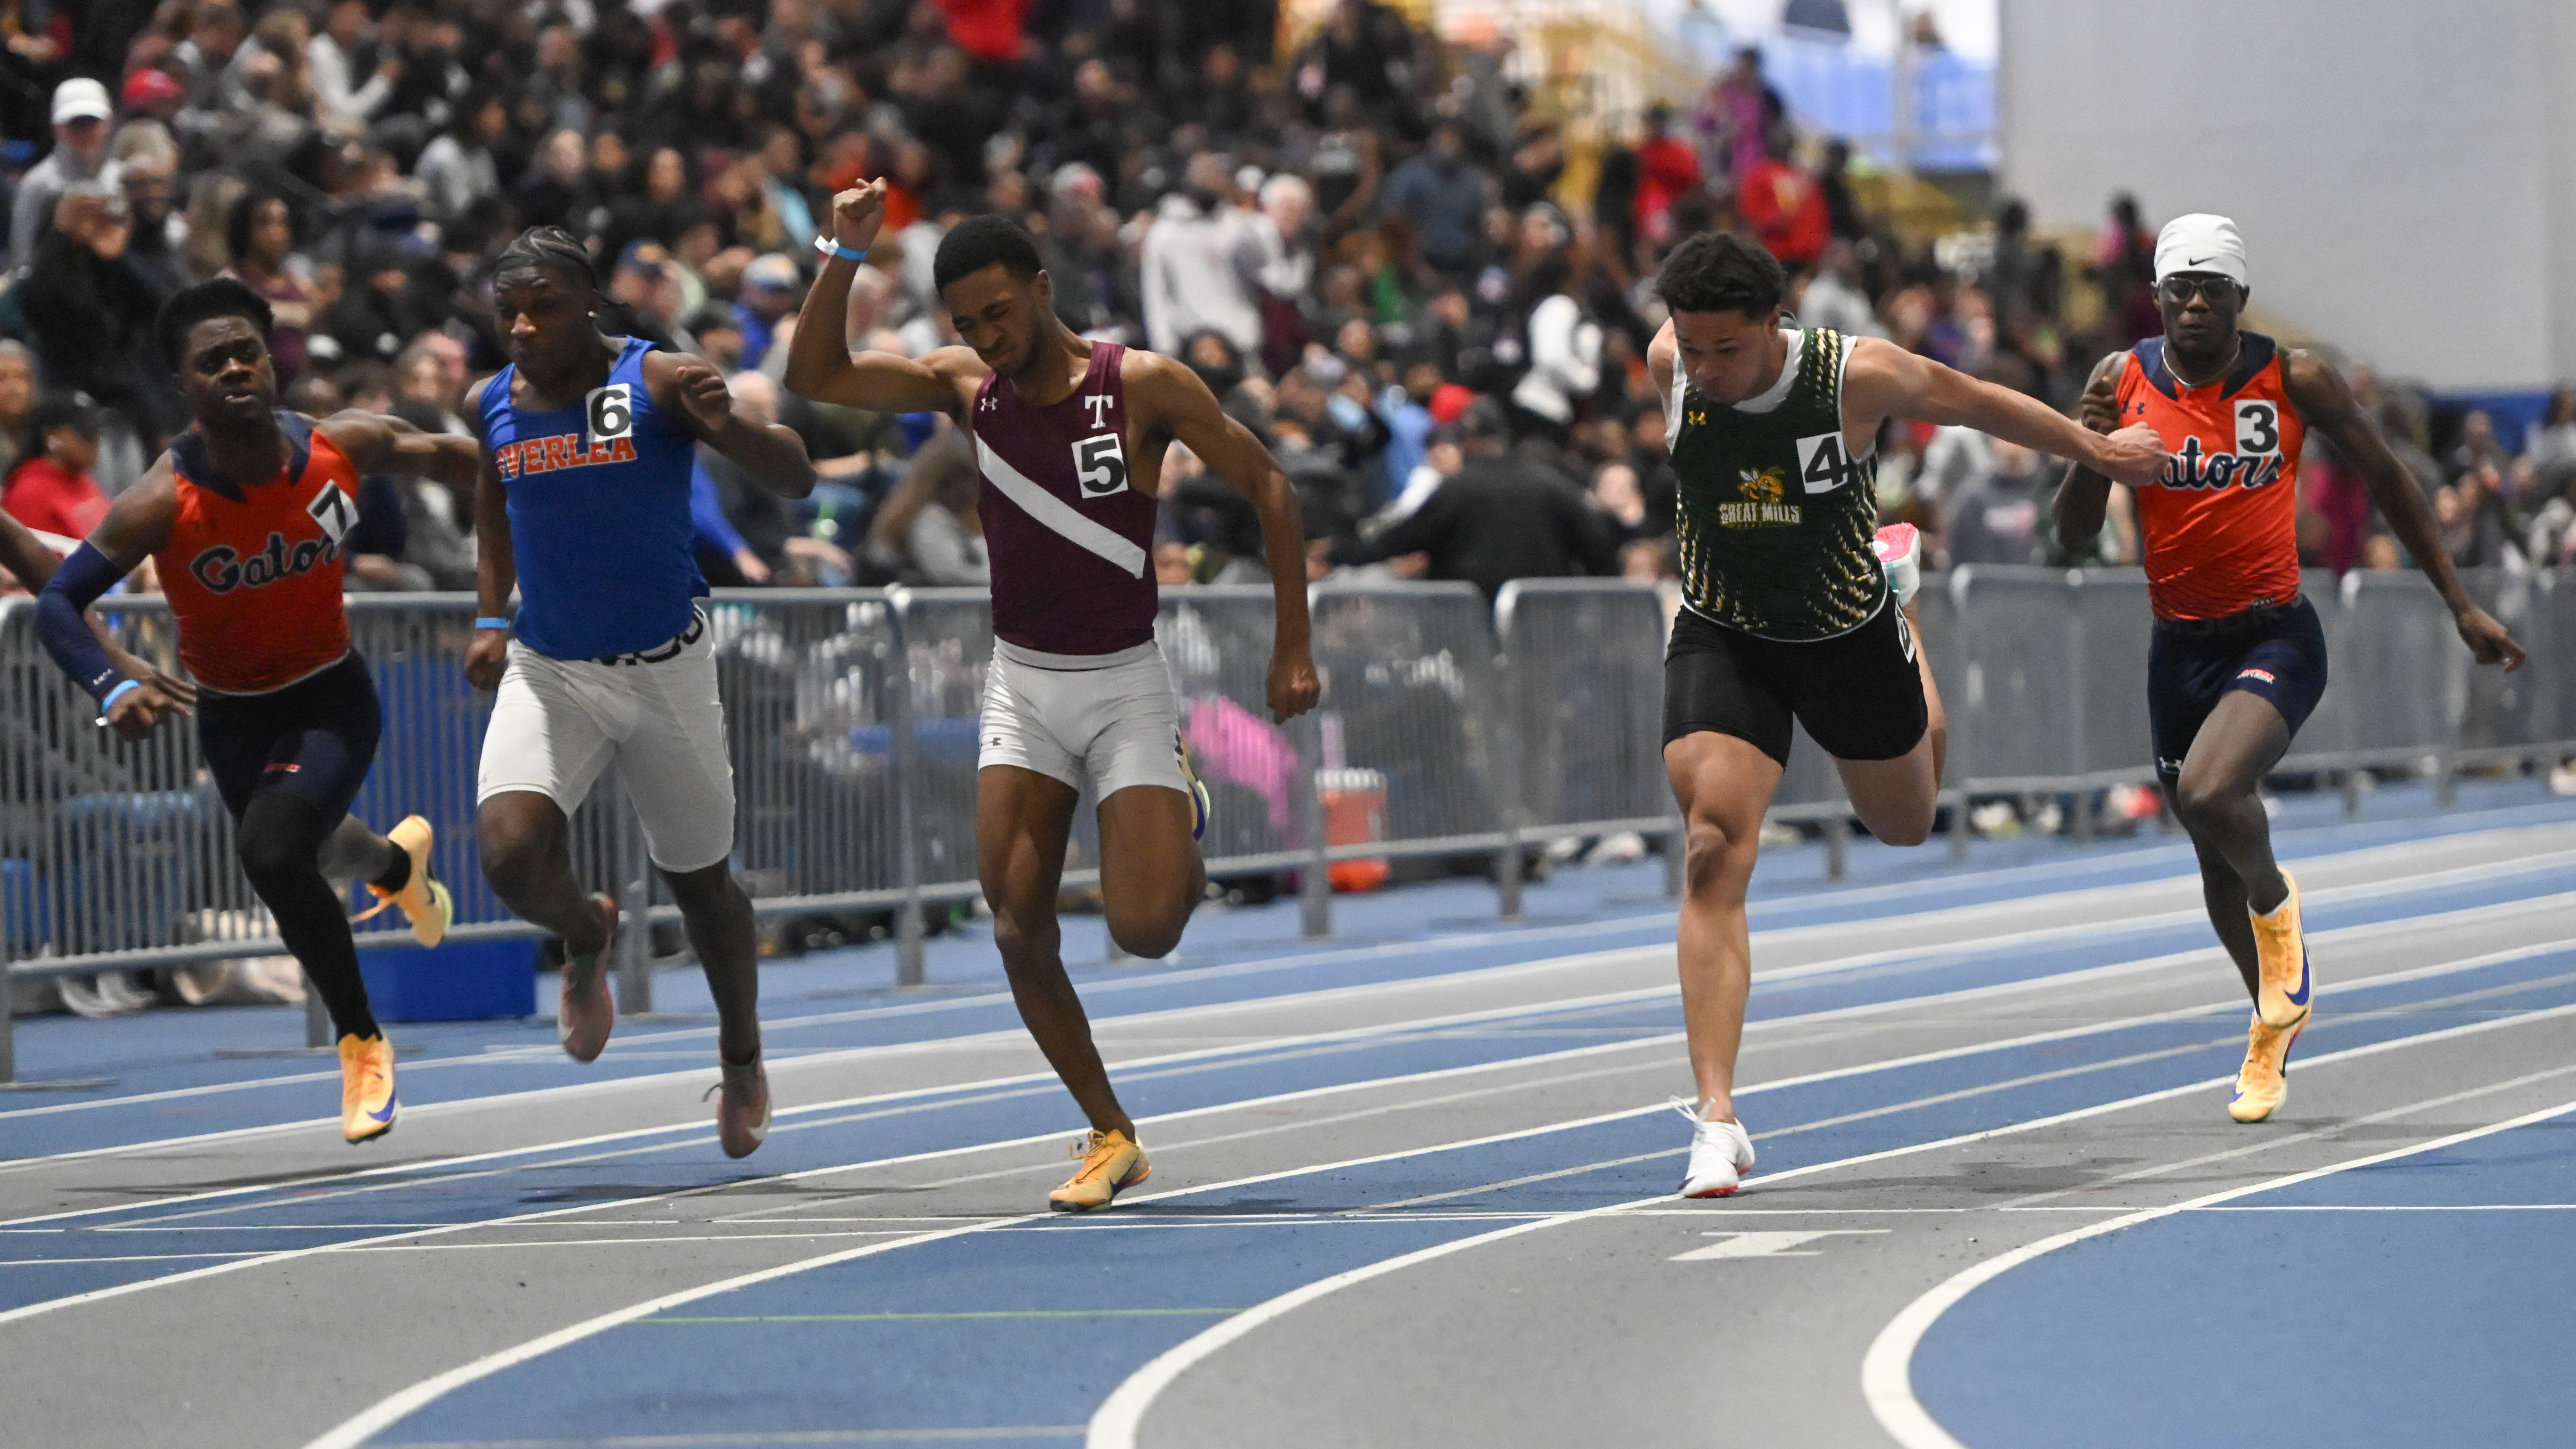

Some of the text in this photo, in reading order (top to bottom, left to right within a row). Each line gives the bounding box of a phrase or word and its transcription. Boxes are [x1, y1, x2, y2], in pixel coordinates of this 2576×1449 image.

[590, 389, 631, 437] 6
[1085, 394, 1113, 429] T
[2239, 404, 2278, 453] 3
[495, 432, 638, 479] VERLEA
[1080, 438, 1125, 493] 5
[1804, 435, 1848, 485] 4
[2159, 434, 2284, 491] ators
[311, 484, 347, 536] 7
[1719, 502, 1800, 524] GREAT MILLS
[190, 531, 339, 594] Gator
